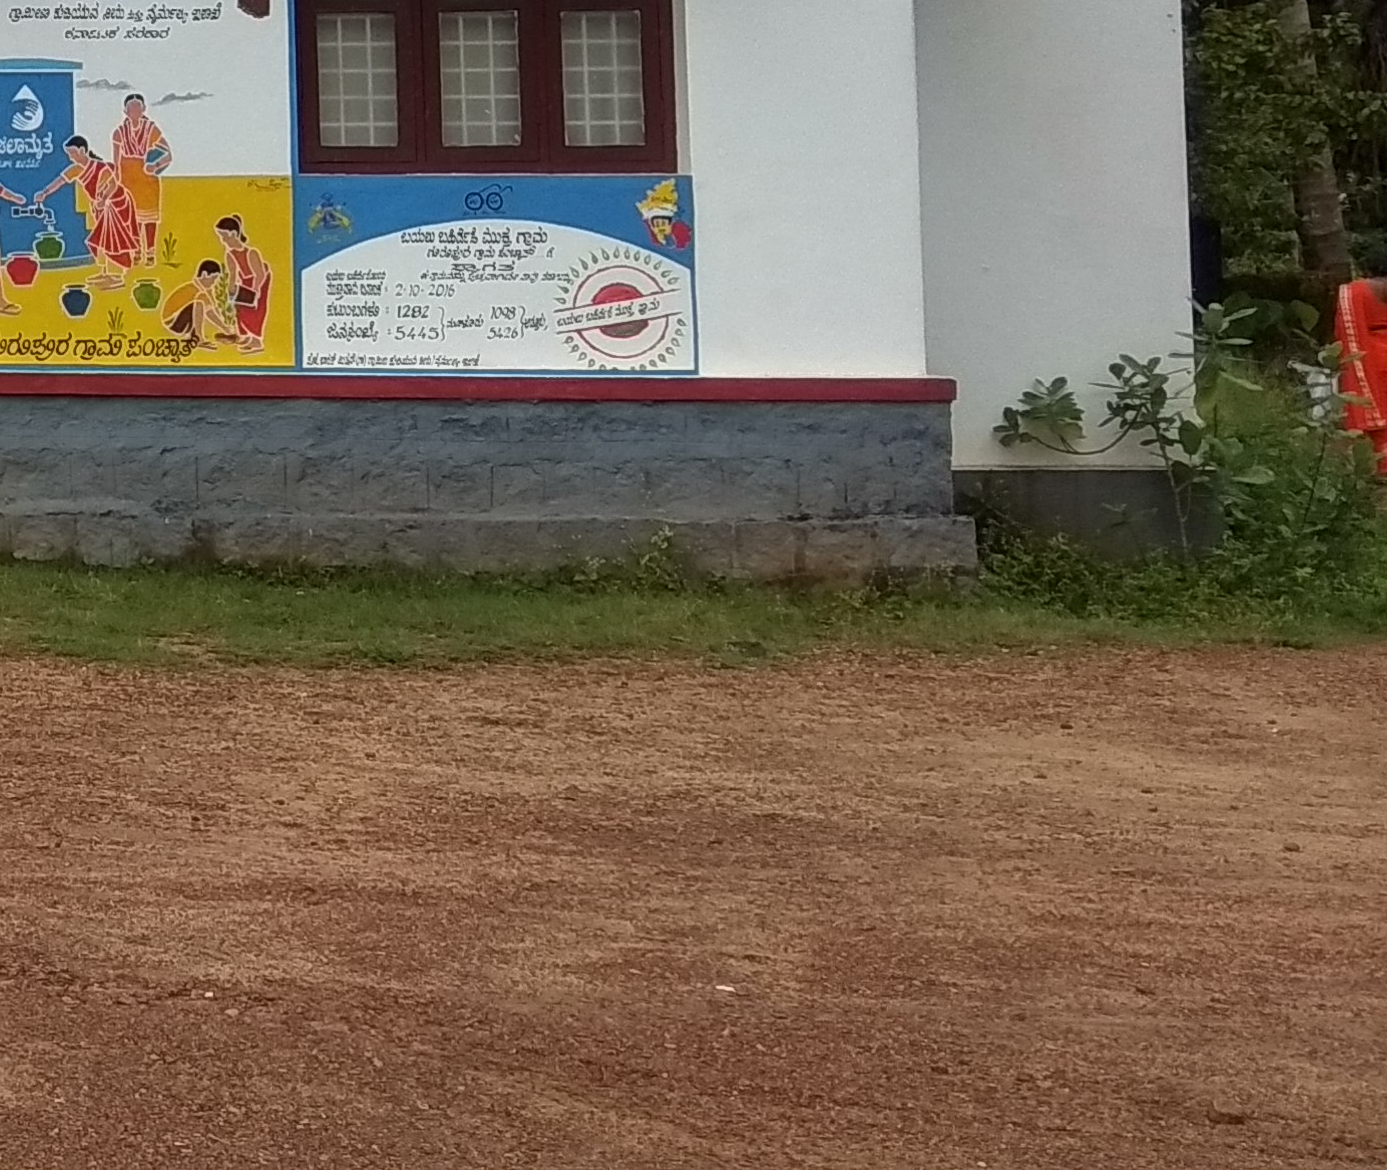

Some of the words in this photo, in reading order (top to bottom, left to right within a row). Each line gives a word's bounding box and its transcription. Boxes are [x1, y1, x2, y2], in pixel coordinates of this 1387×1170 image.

[397, 305, 430, 319] 1282
[395, 325, 439, 341] 5445
[487, 326, 518, 340] 5426
